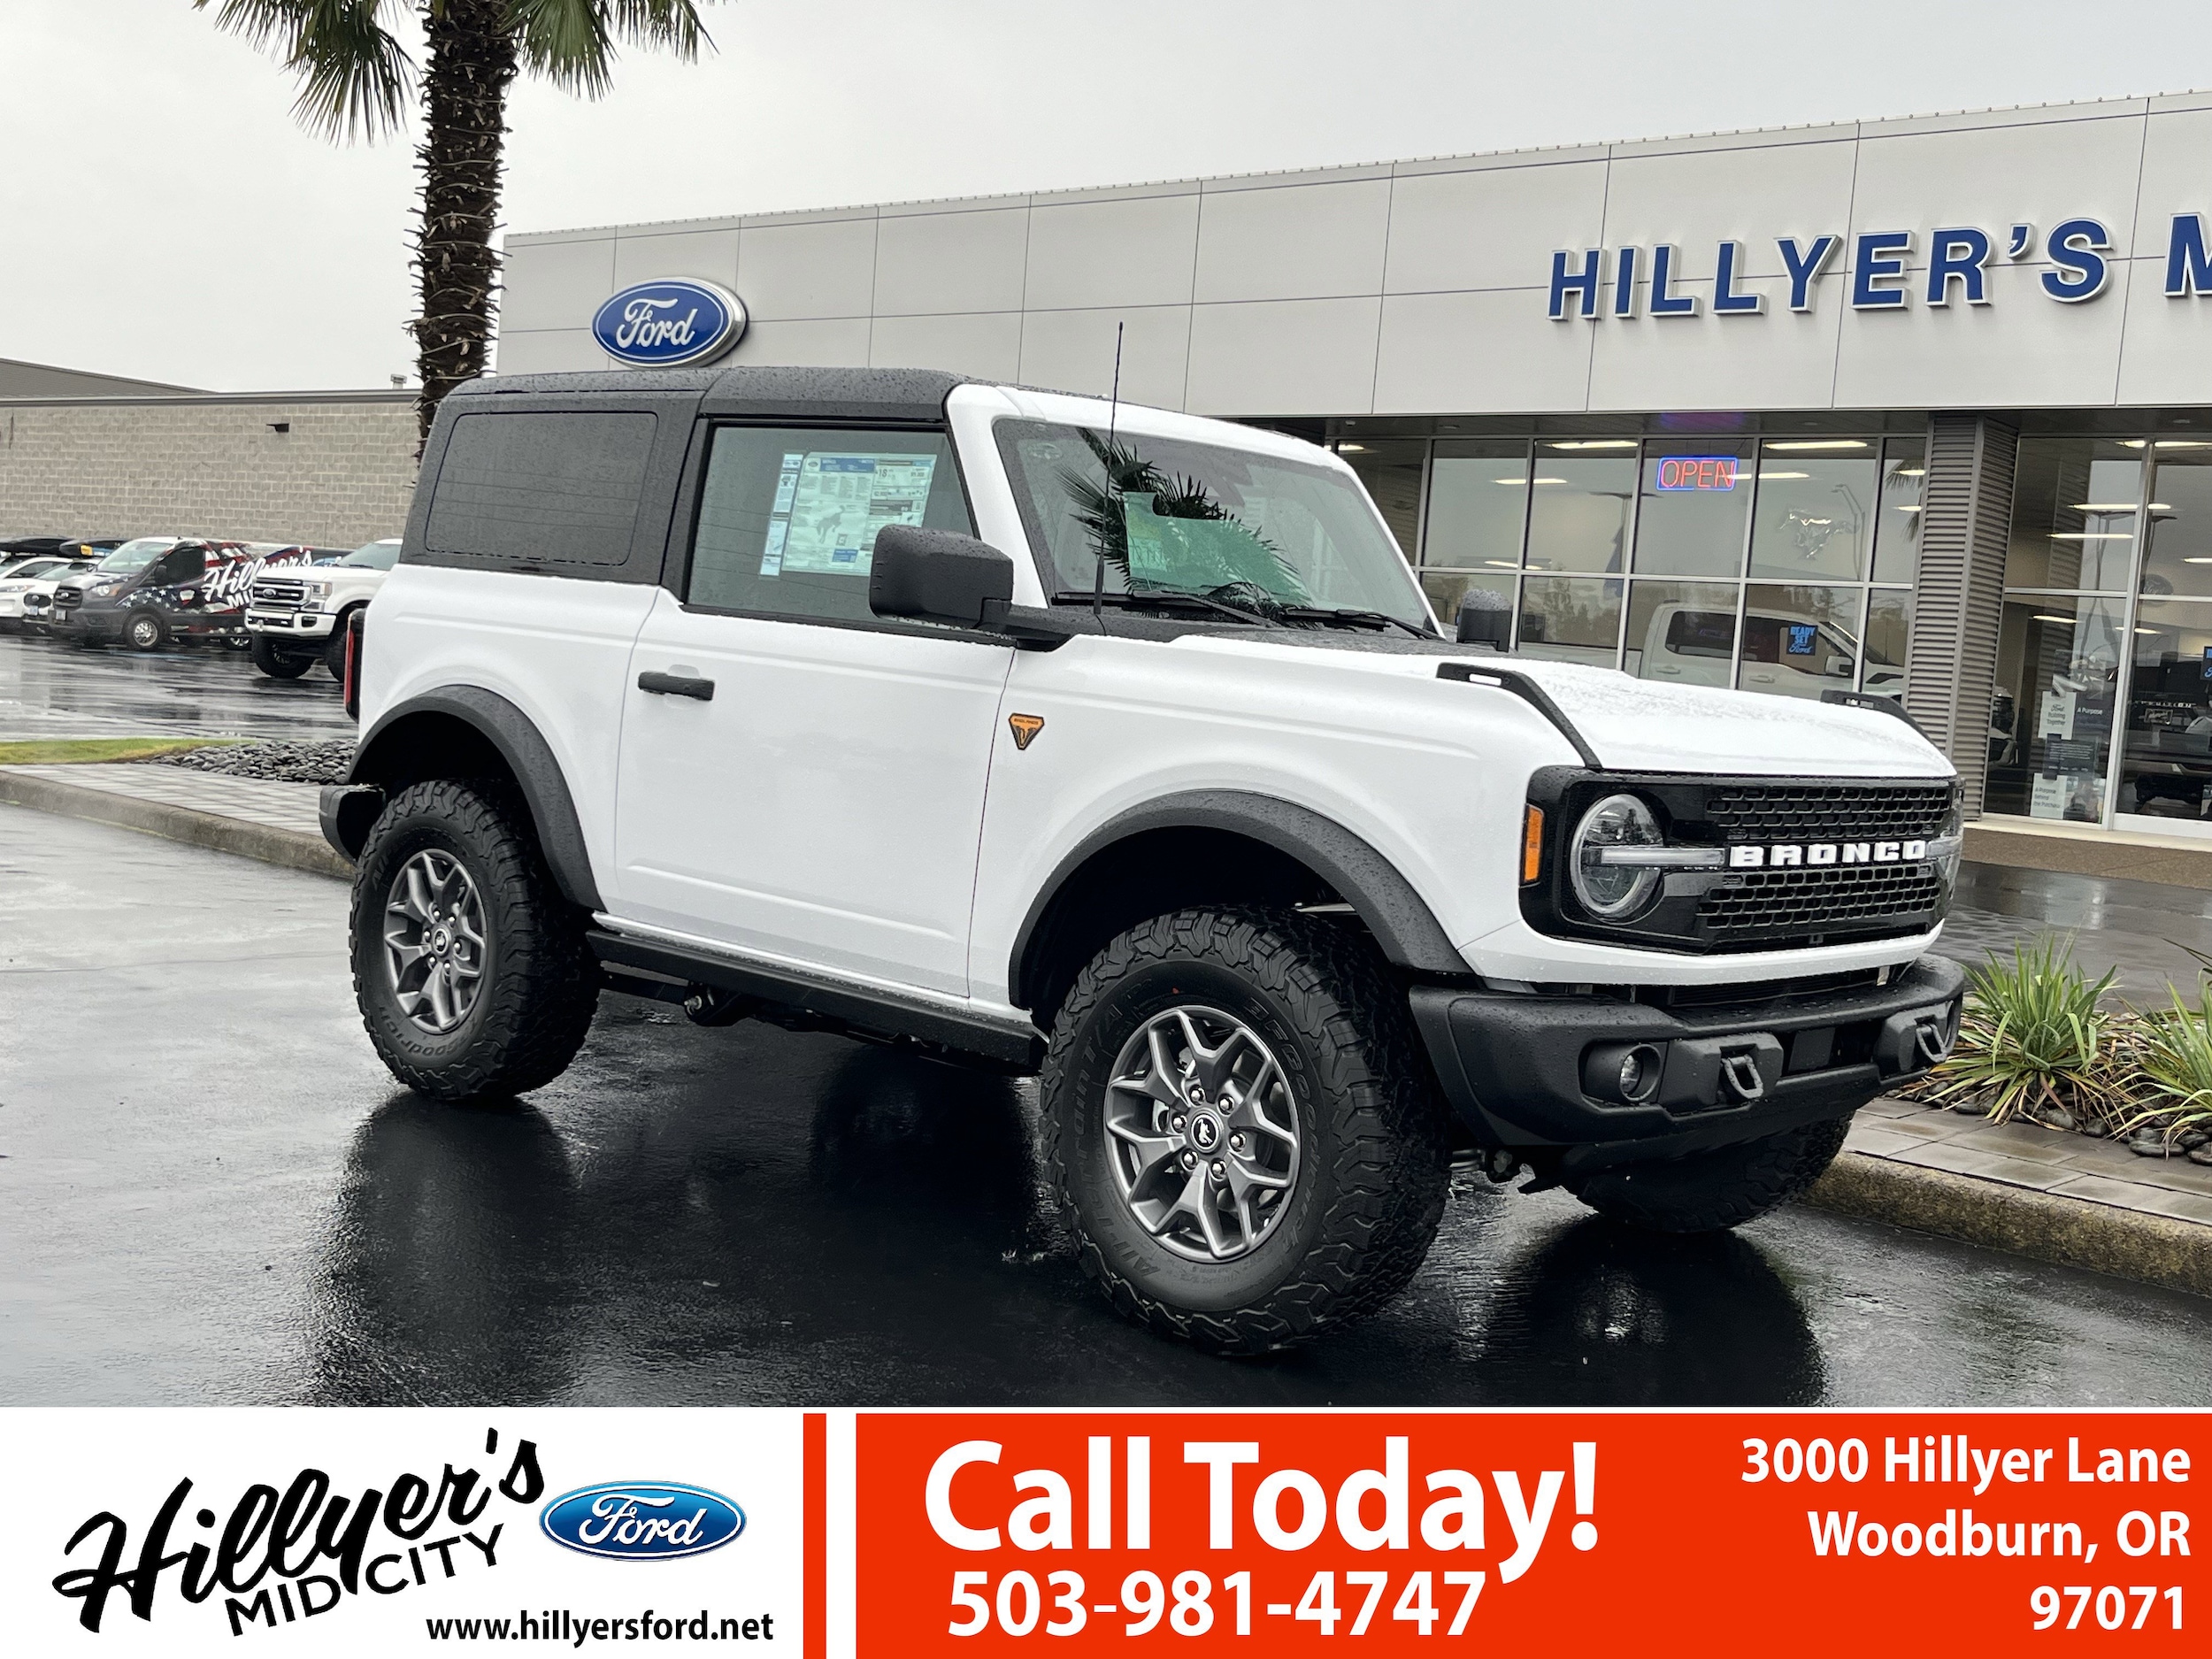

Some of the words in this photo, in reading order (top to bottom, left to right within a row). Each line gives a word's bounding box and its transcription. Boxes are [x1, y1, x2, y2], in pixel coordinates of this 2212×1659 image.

[1548, 218, 2113, 318] HILLYER'S
[616, 298, 698, 349] Ford
[1661, 459, 1735, 488] OPEN
[1790, 626, 1816, 636] READY
[1794, 635, 1809, 644] SET
[1788, 644, 1813, 654] Ford
[1729, 840, 1926, 868] BRONCO
